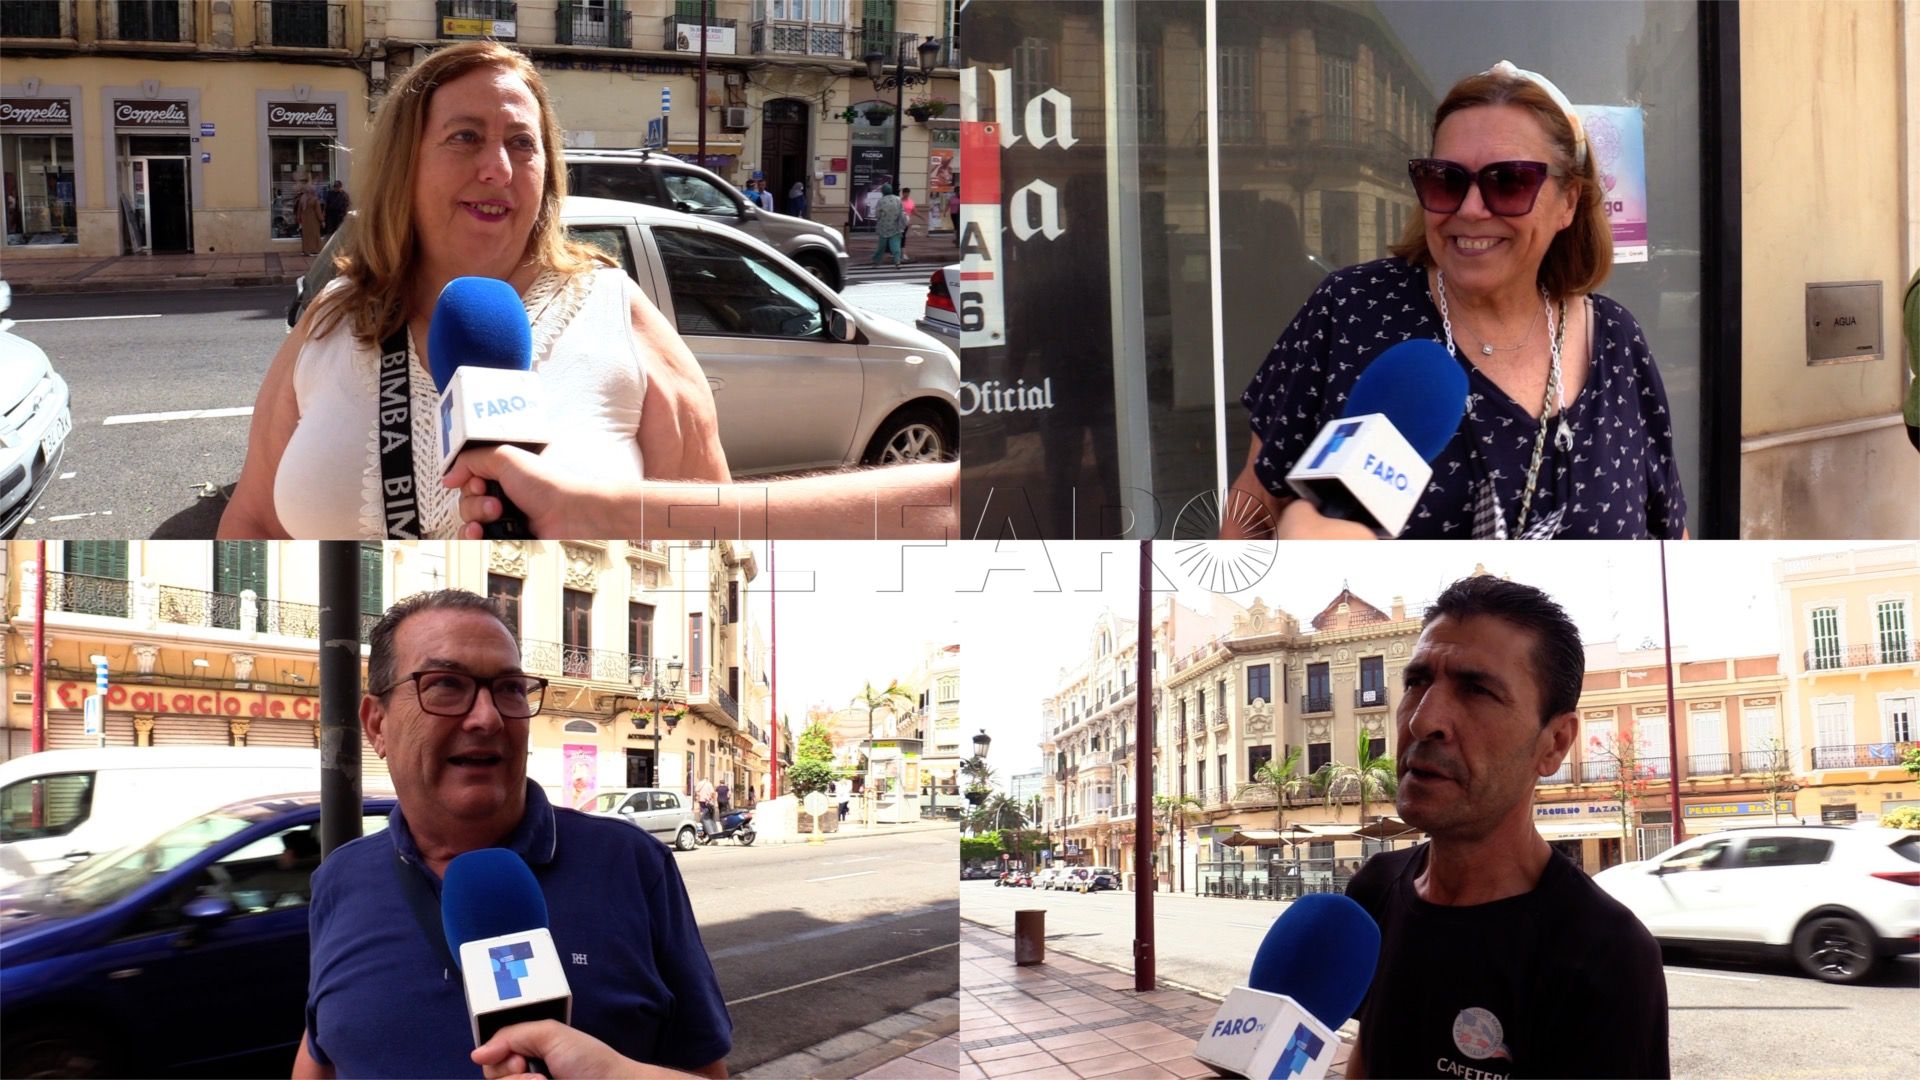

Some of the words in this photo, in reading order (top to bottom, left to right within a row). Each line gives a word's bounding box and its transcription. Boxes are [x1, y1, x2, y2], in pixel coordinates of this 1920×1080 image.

[0, 102, 69, 122] Coppelia
[117, 104, 187, 123] Coppelia
[270, 106, 335, 125] Coppelia
[1834, 316, 1857, 327] AGUA
[381, 351, 409, 454] BIMBA
[473, 395, 527, 419] FARO
[960, 377, 1055, 416] Oficial
[1363, 453, 1409, 491] FARO
[249, 693, 285, 718] de
[571, 953, 588, 965] RH
[1211, 1016, 1258, 1037] FARO
